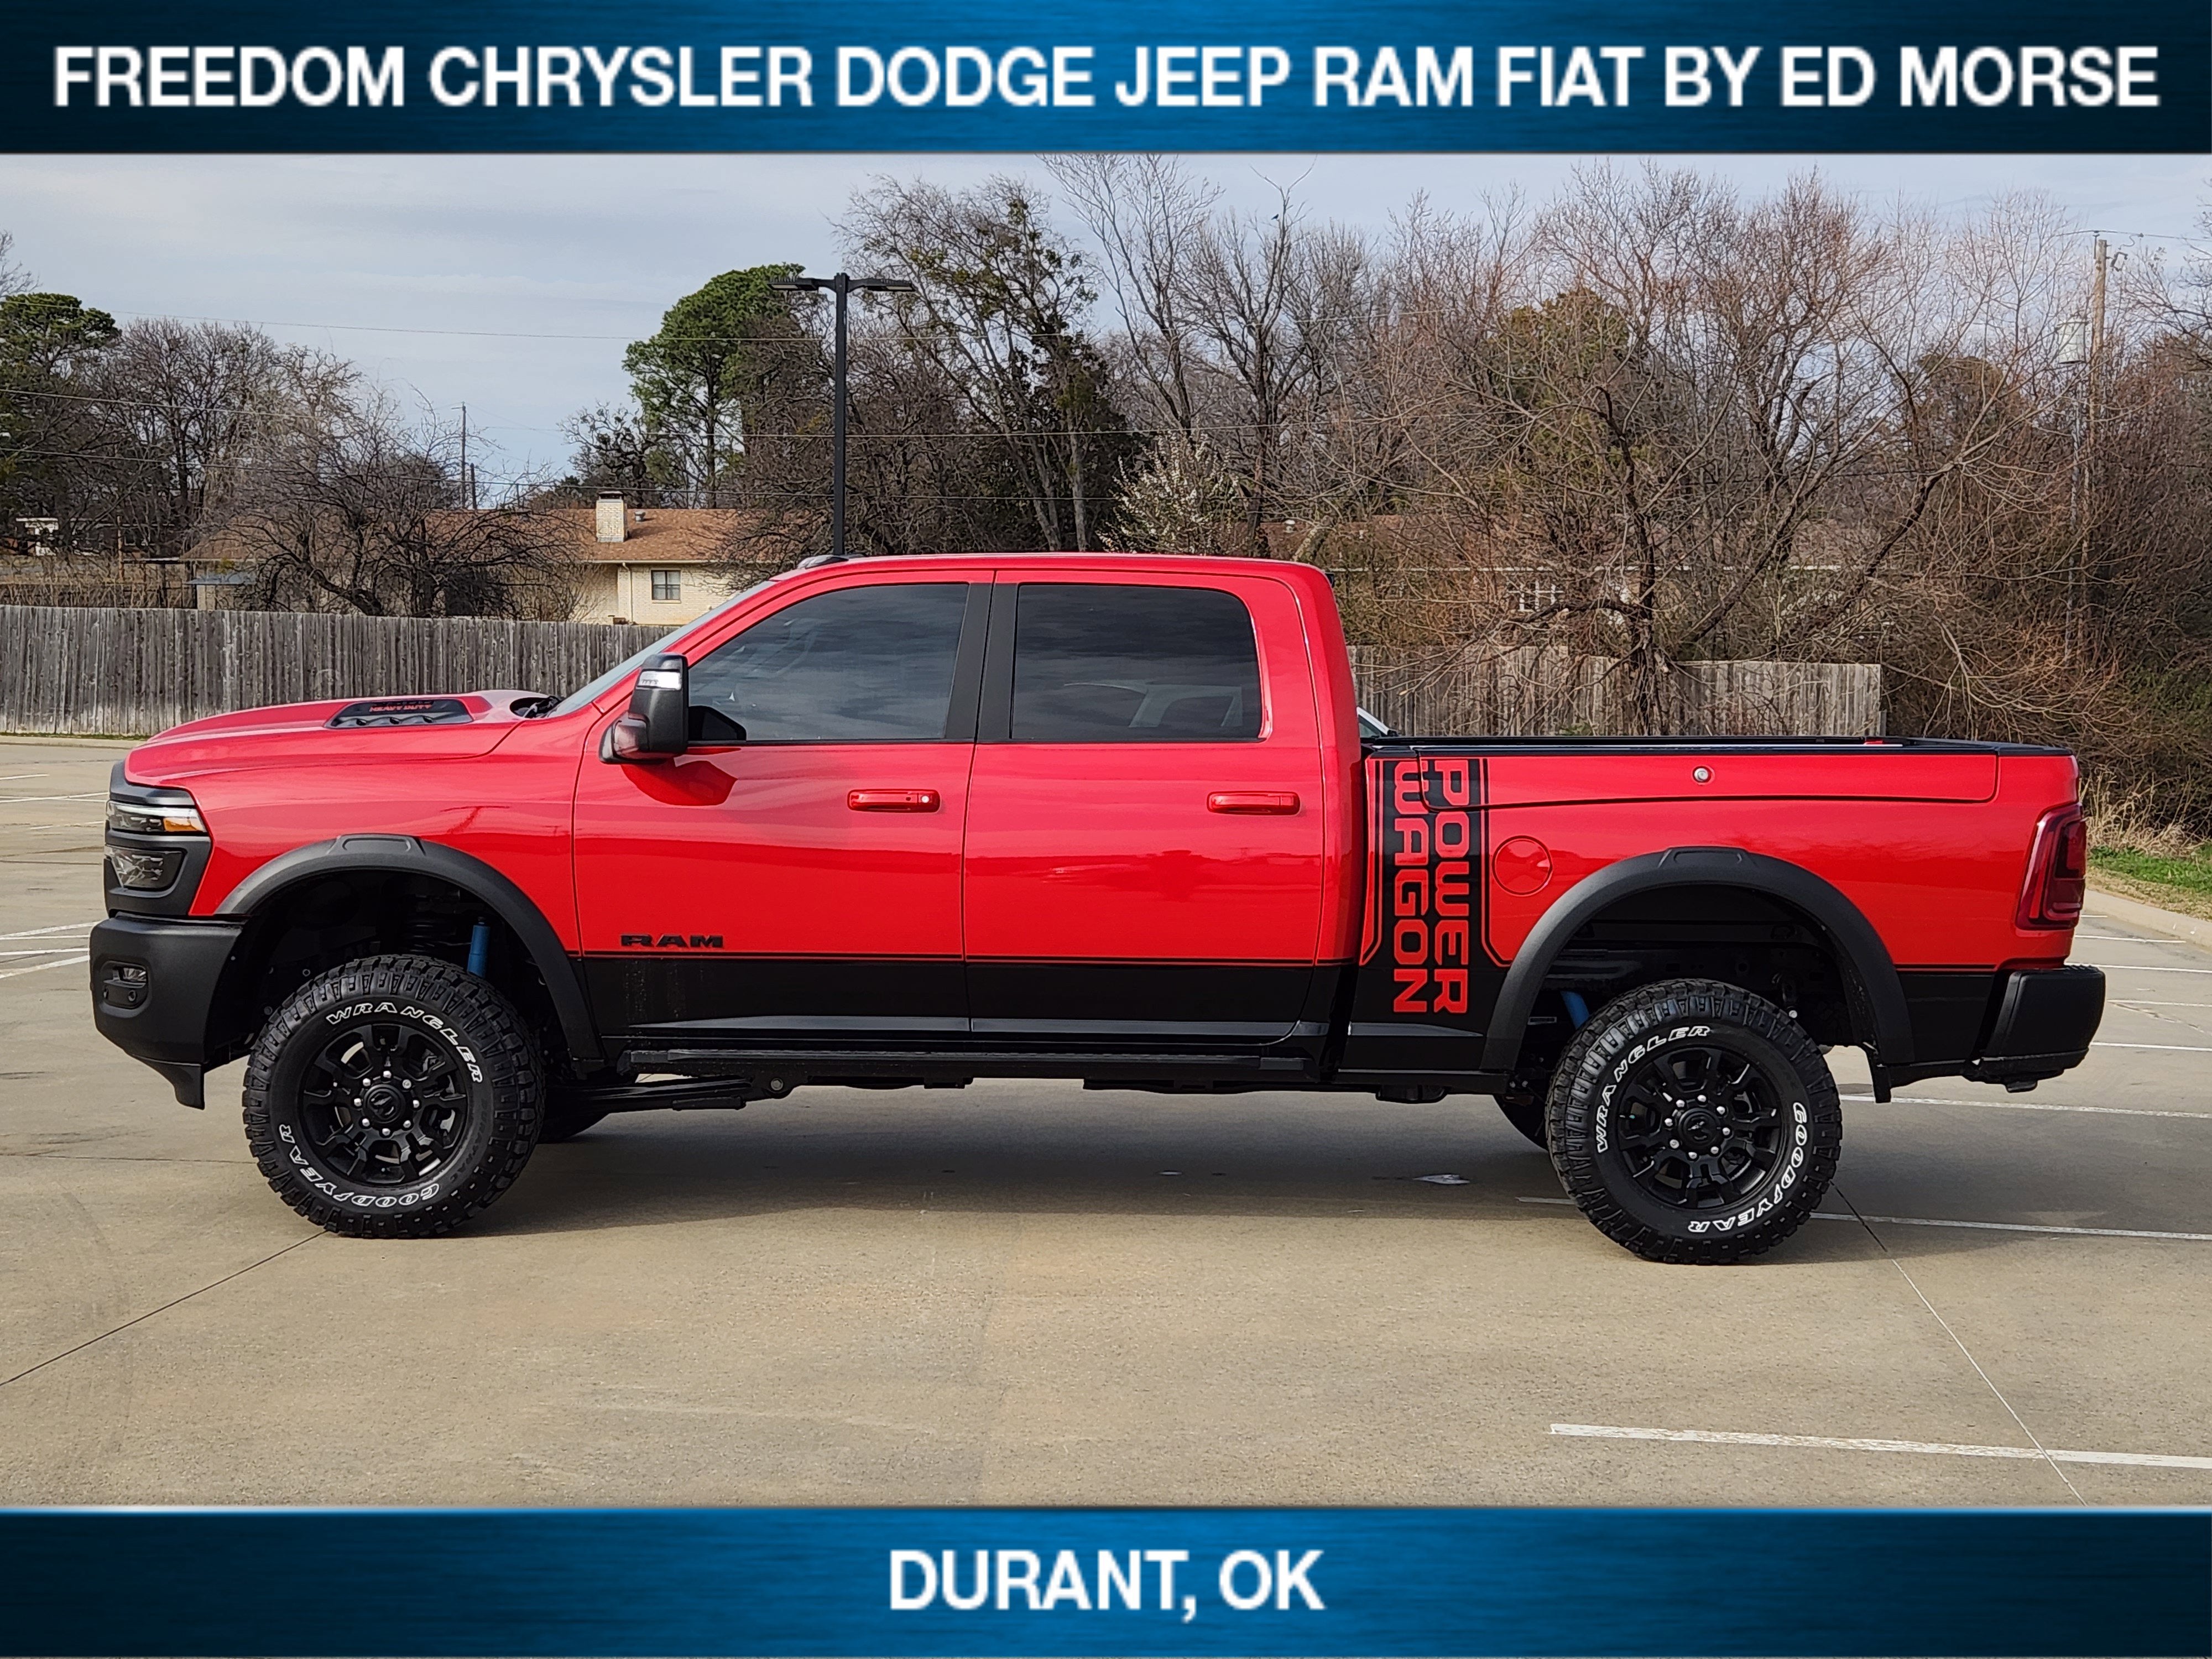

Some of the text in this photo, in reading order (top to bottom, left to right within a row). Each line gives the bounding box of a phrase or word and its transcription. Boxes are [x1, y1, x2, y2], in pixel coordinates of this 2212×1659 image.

[620, 933, 724, 948] RAM
[1394, 760, 1430, 1013] WAGON
[1434, 759, 1470, 1014] POWER
[326, 1001, 484, 1084] WRANGLER
[1596, 1025, 1712, 1153] WRANGLER
[279, 1123, 440, 1208] GOODYEAR
[1687, 1102, 1808, 1233] GOODYEAR
